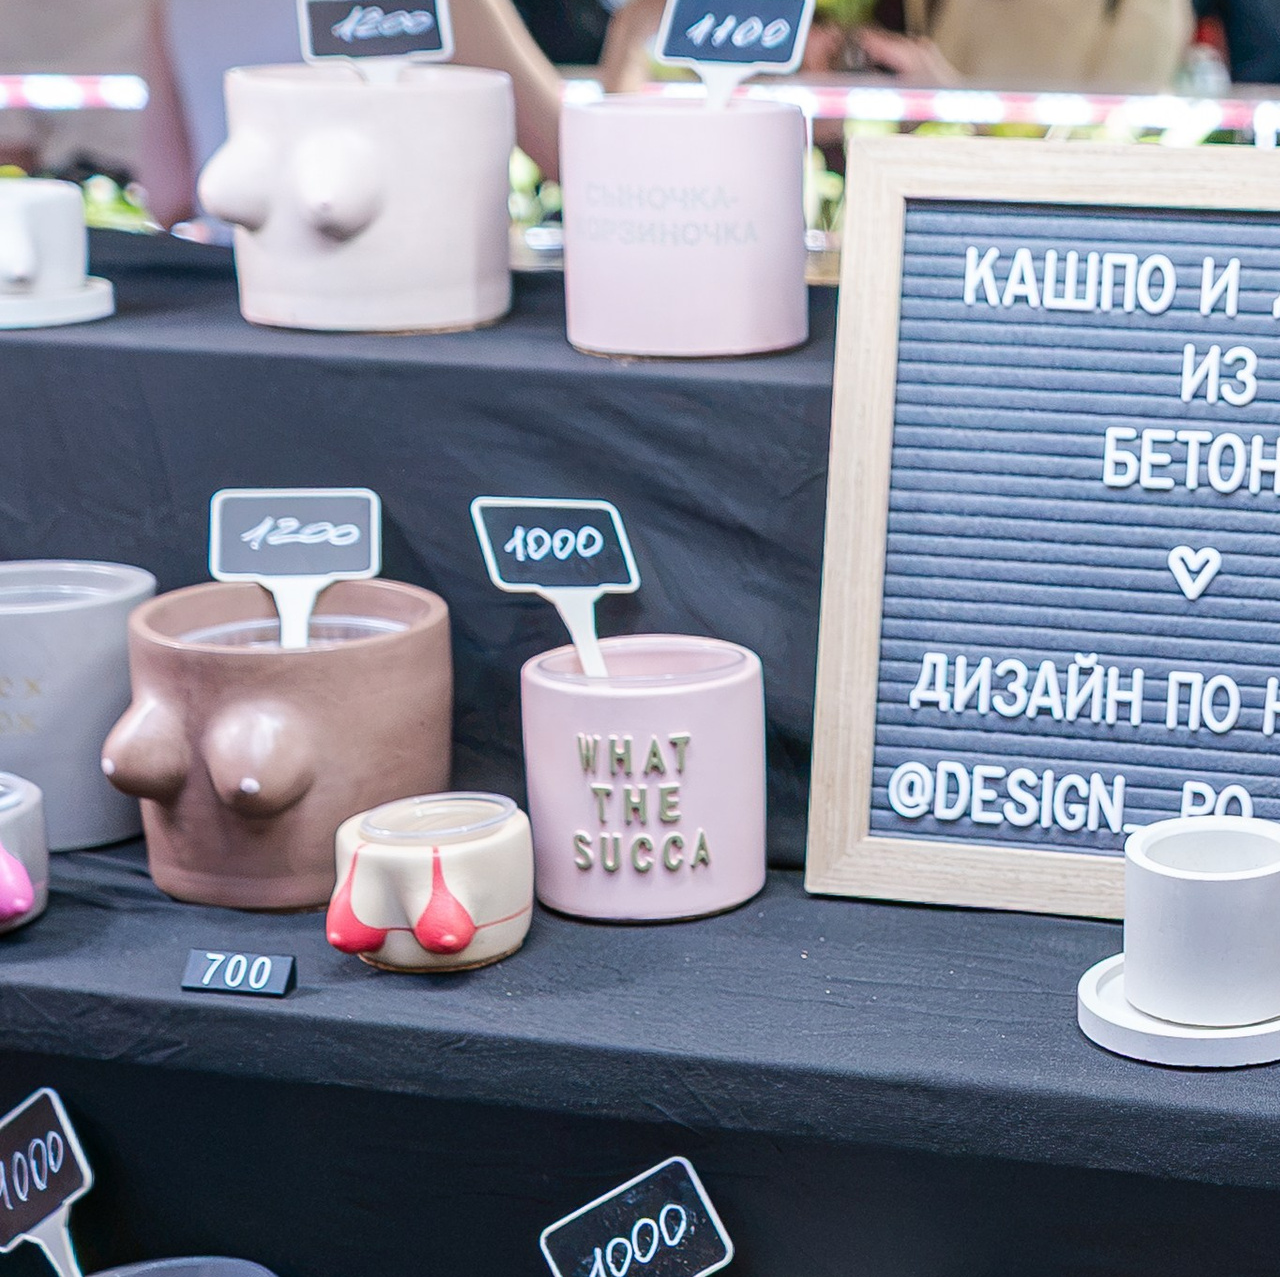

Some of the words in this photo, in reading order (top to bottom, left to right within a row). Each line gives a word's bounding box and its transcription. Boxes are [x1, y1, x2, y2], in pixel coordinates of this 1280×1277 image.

[963, 246, 1177, 315] КАШПО
[1202, 256, 1241, 318] И
[1180, 343, 1259, 407] ИЗ
[240, 515, 360, 552] 1200
[504, 524, 605, 562] 1000
[908, 651, 1145, 728] ДИЗАЙН
[1166, 672, 1241, 735] ПО
[577, 731, 692, 777] WHAT
[590, 781, 682, 826] THE
[573, 827, 711, 874] SUCCA
[201, 953, 273, 990] 700
